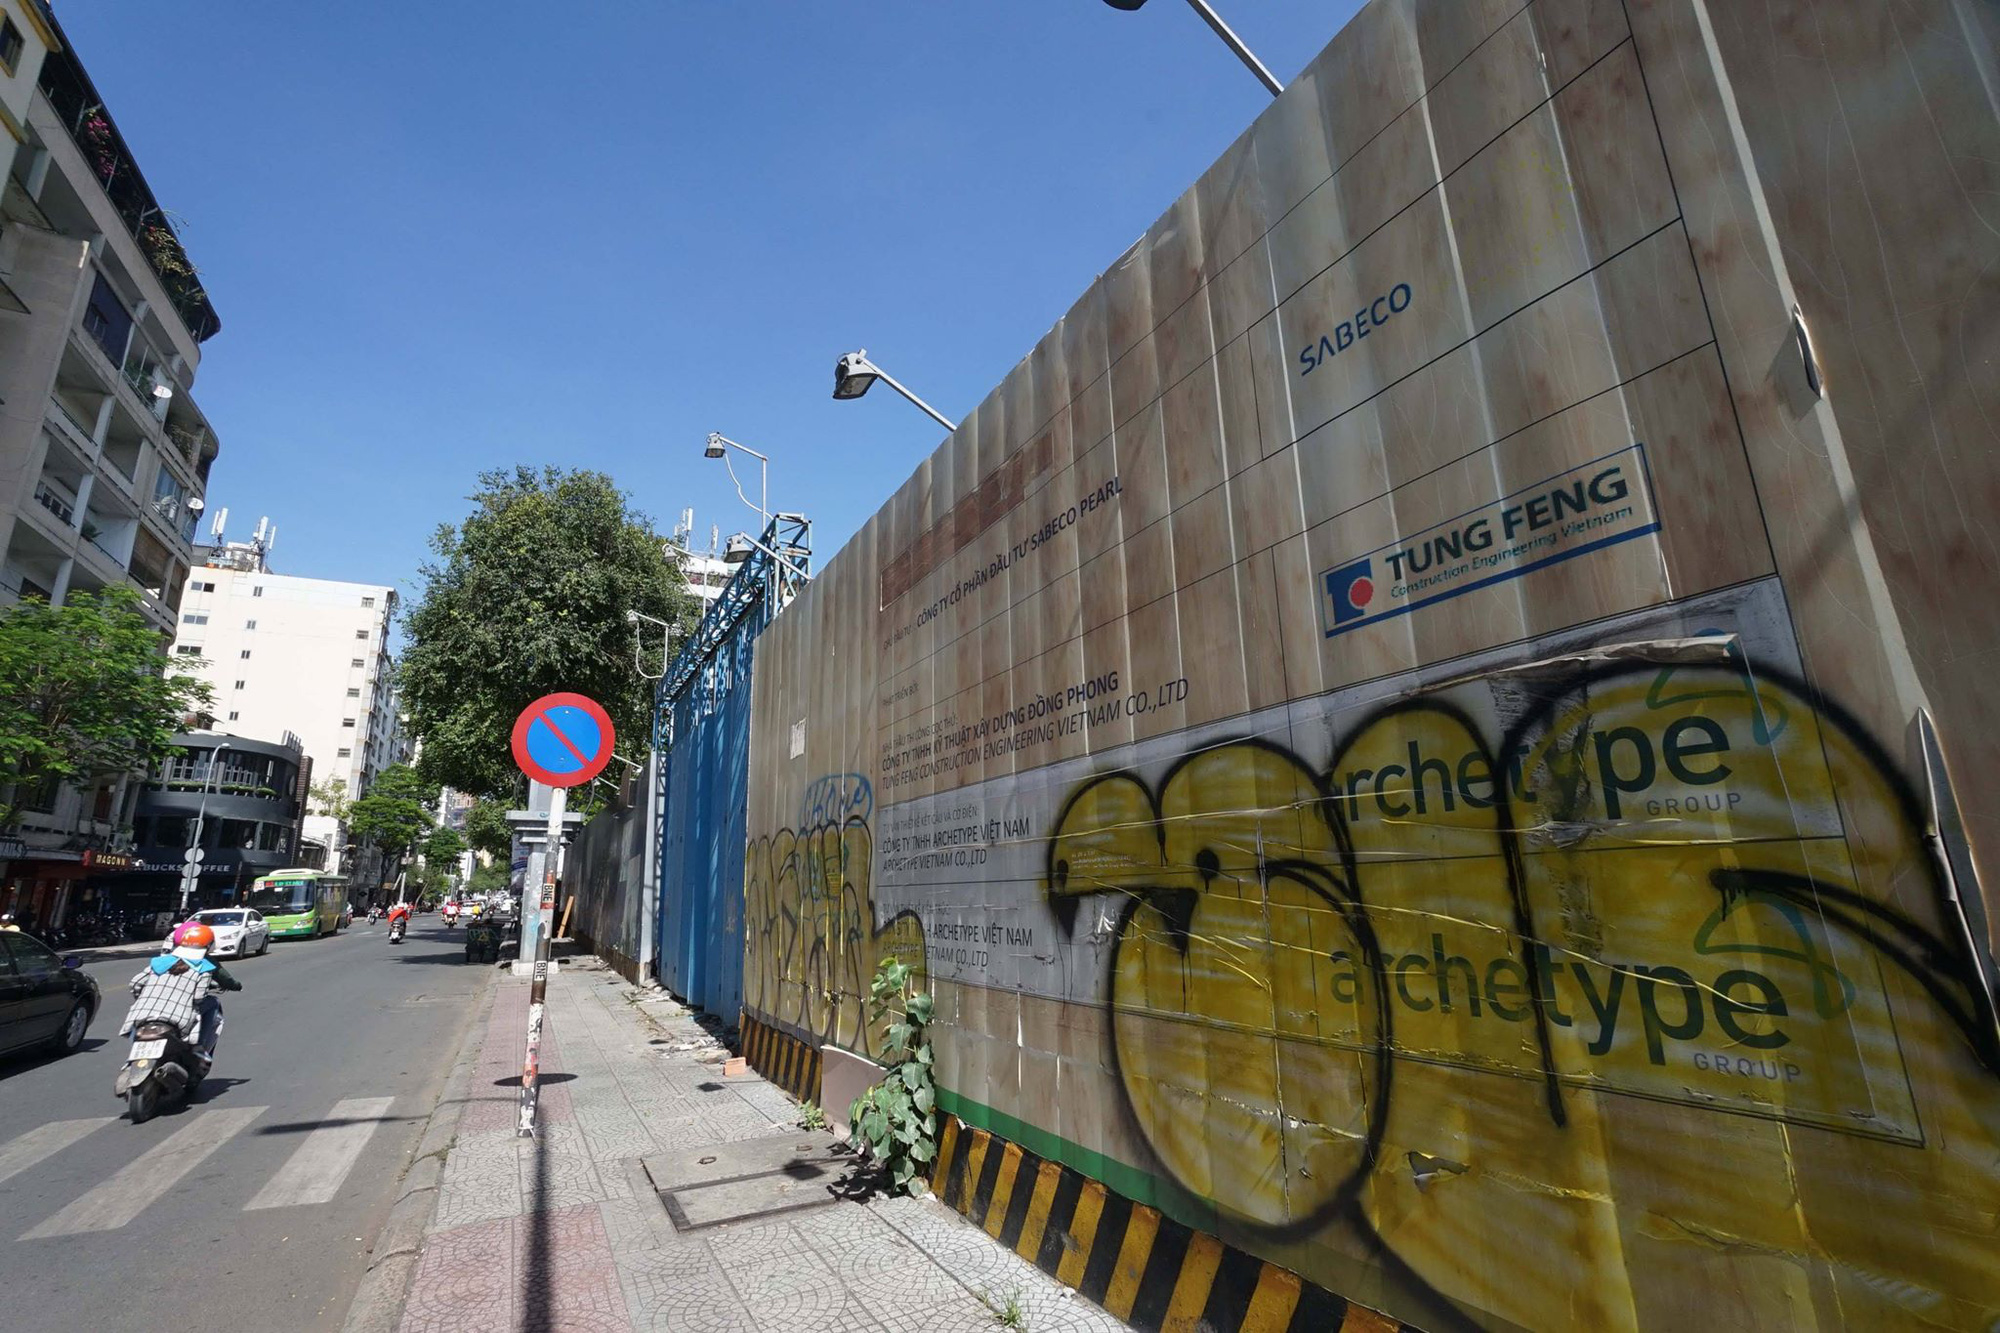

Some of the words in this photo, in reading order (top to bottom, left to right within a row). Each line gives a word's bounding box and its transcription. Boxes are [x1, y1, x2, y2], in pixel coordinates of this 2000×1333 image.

[1300, 282, 1412, 377] SABECO
[1385, 518, 1493, 582] TUNG
[1501, 466, 1629, 541] FENG
[917, 603, 938, 628] CÔNG
[939, 594, 949, 613] TY
[963, 568, 987, 598] PHẦN
[989, 553, 1011, 579] ĐẦU
[1012, 537, 1029, 563] TƯ
[1031, 506, 1077, 552] SABECO
[1080, 477, 1123, 518] PEARL
[1391, 563, 1469, 599] Construction
[1472, 532, 1557, 573] Engineering
[1561, 505, 1634, 538] Vietnam
[882, 754, 901, 773] CÔNG
[902, 749, 912, 766] TY
[912, 742, 932, 763] TNHH
[944, 725, 972, 749] THUẬT
[973, 717, 991, 740] XÂY
[992, 706, 1026, 735] DỰNG
[1027, 692, 1064, 722] ĐỒNG
[1067, 671, 1119, 707] PHONG
[882, 772, 900, 791] TUNG
[901, 766, 918, 785] FENG
[919, 745, 982, 781] CONSTRUCTION
[983, 721, 1055, 763] ENGINEERING
[1057, 699, 1122, 738] VIETNAM
[1125, 677, 1190, 717] CO.,LTD
[1645, 791, 1742, 818] GROUP
[882, 837, 902, 854] CÔNG
[902, 836, 912, 852] TY
[911, 832, 932, 850] TNHH
[933, 824, 979, 847] ARCHETYPE
[979, 817, 1002, 847] VIỆT
[1003, 815, 1031, 838] NAM
[882, 855, 919, 872] ARCHETYPE
[919, 850, 954, 870] VIETNAM
[954, 848, 988, 869] CO.,LTD
[543, 885, 554, 902] BNE
[933, 922, 981, 943] ARCHETYPE
[981, 921, 1005, 948] VIỆT
[1005, 926, 1034, 948] NAM
[535, 961, 547, 981] BNE
[954, 948, 990, 968] CO.,LTD
[1693, 1050, 1803, 1084] GROUP
